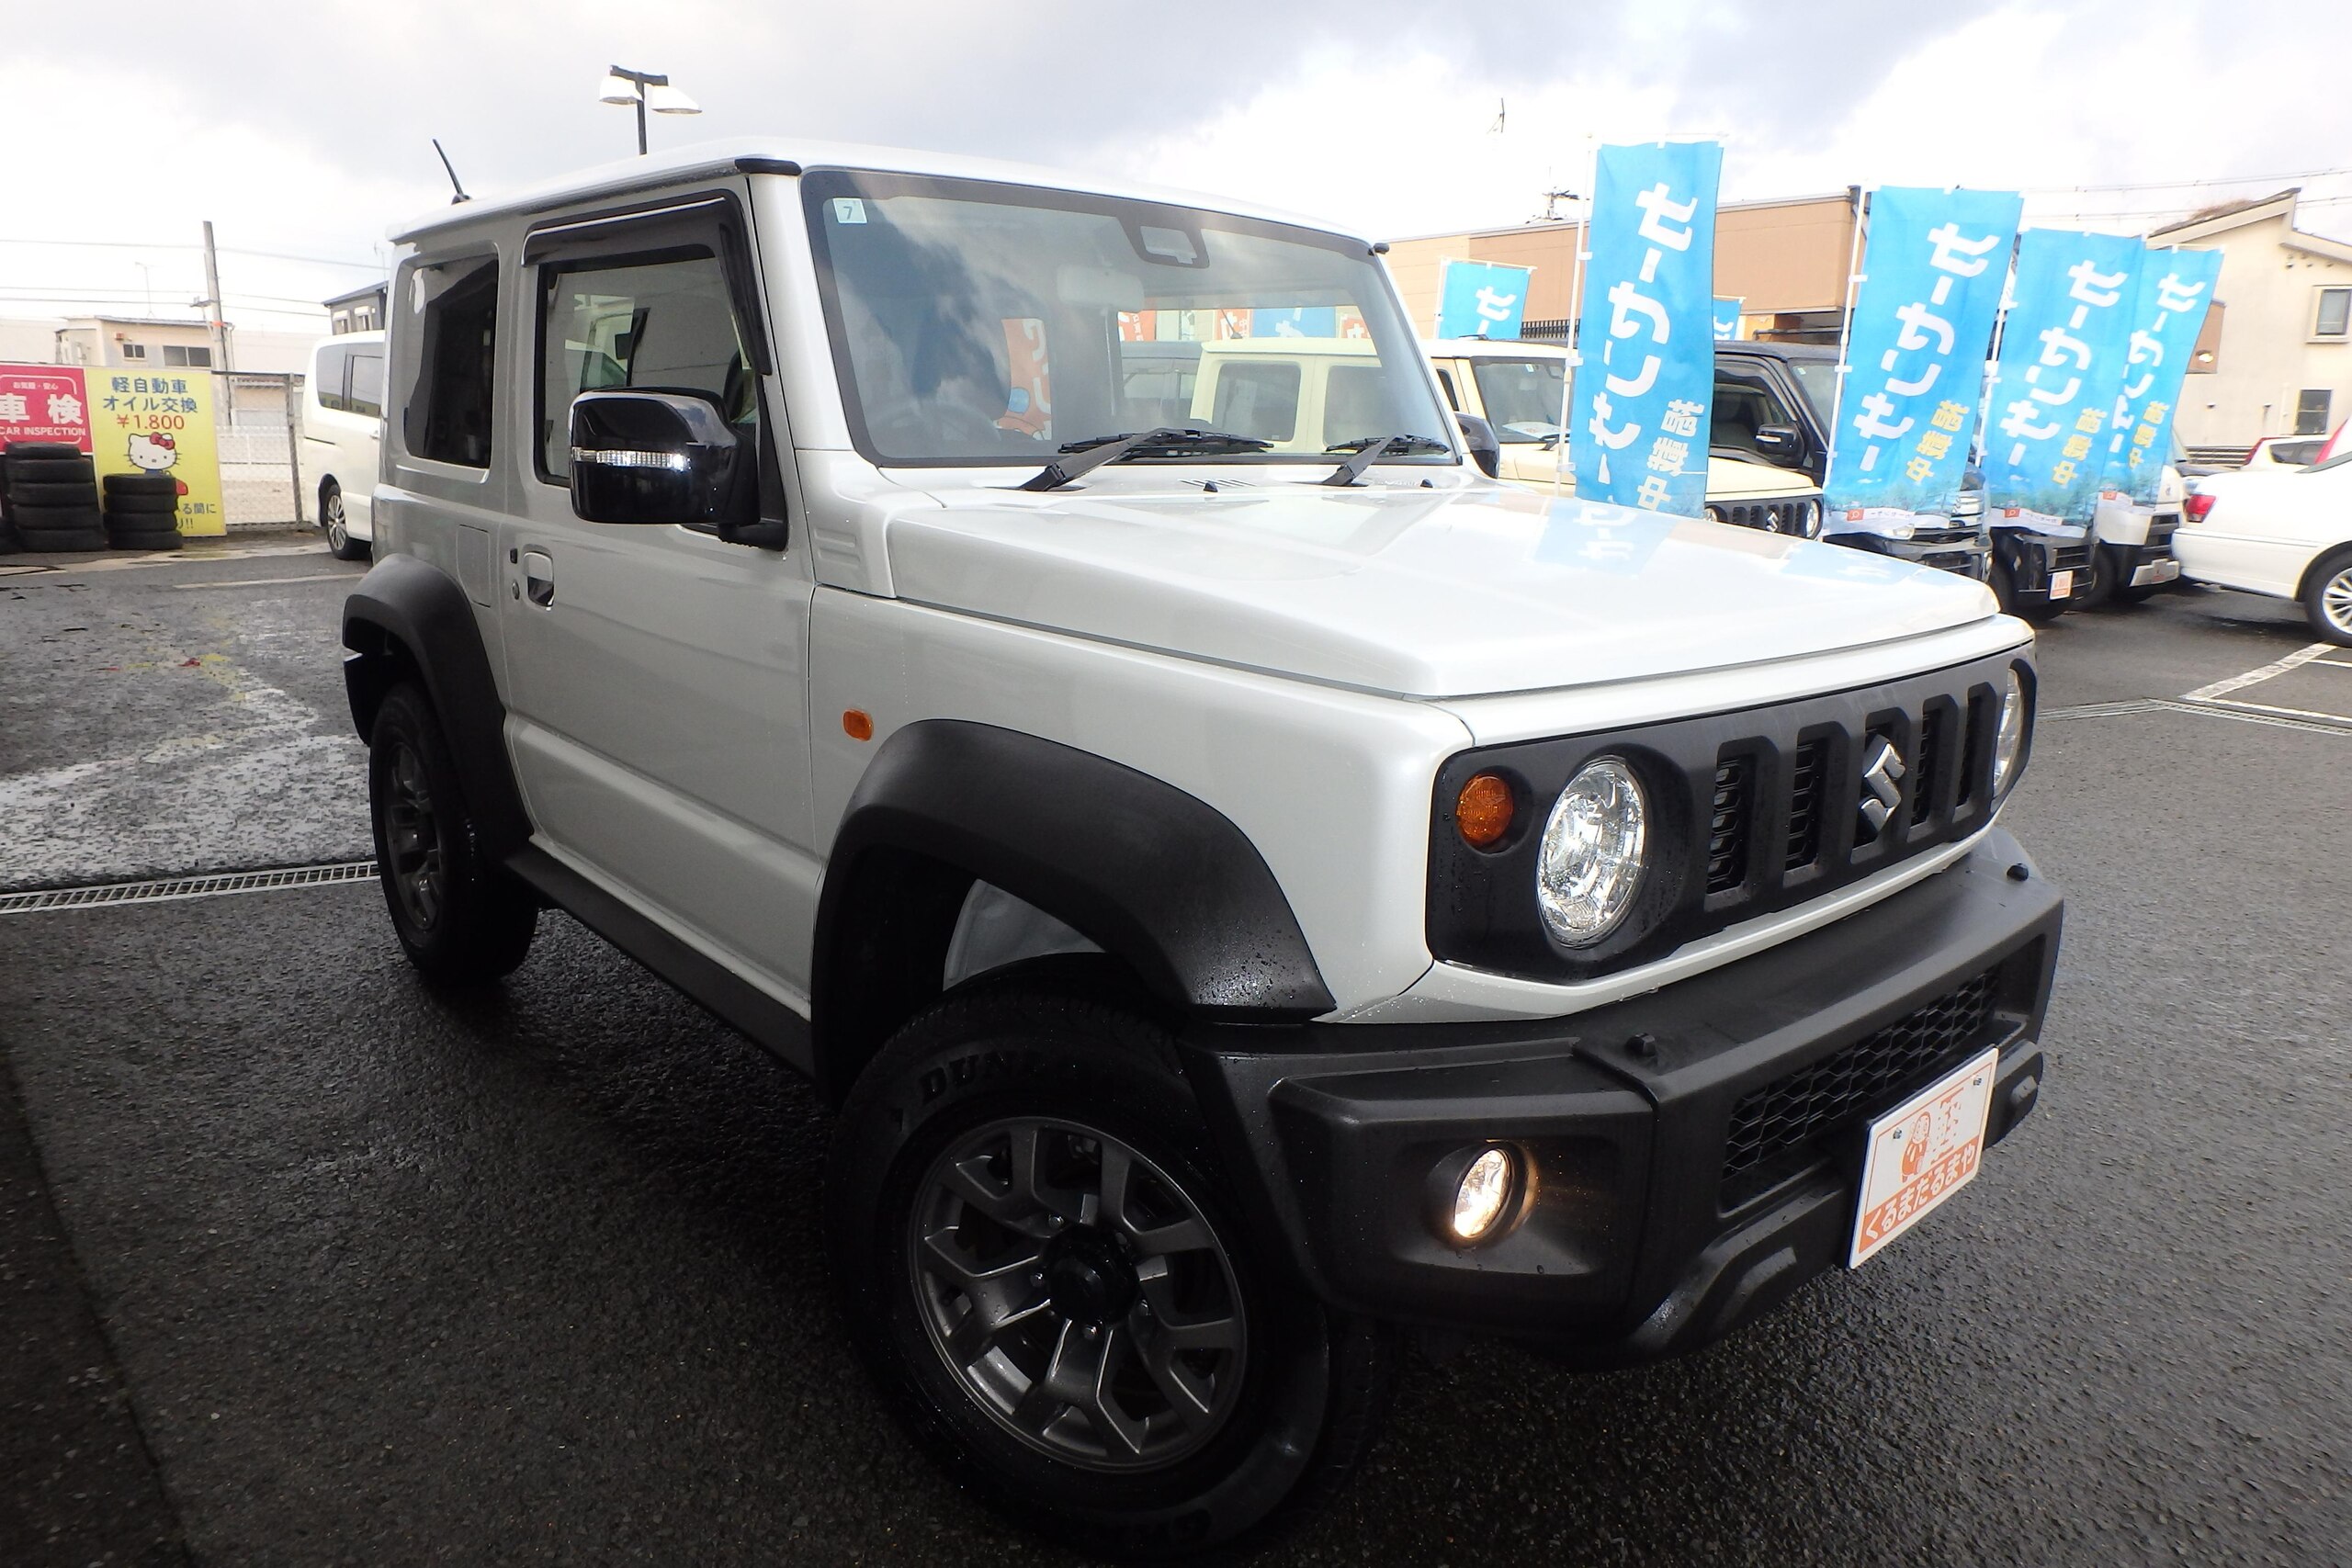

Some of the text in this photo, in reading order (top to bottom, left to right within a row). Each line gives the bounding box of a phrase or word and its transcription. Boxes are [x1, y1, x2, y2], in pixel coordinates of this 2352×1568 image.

[842, 206, 854, 220] 7
[111, 377, 189, 395] 軽自動車
[0, 392, 84, 424] 車検
[103, 395, 198, 413] オイル交換
[0, 426, 85, 436] CAR INSPECTION
[178, 502, 217, 514] る間に
[1866, 1144, 1975, 1240] くるまだるまや
